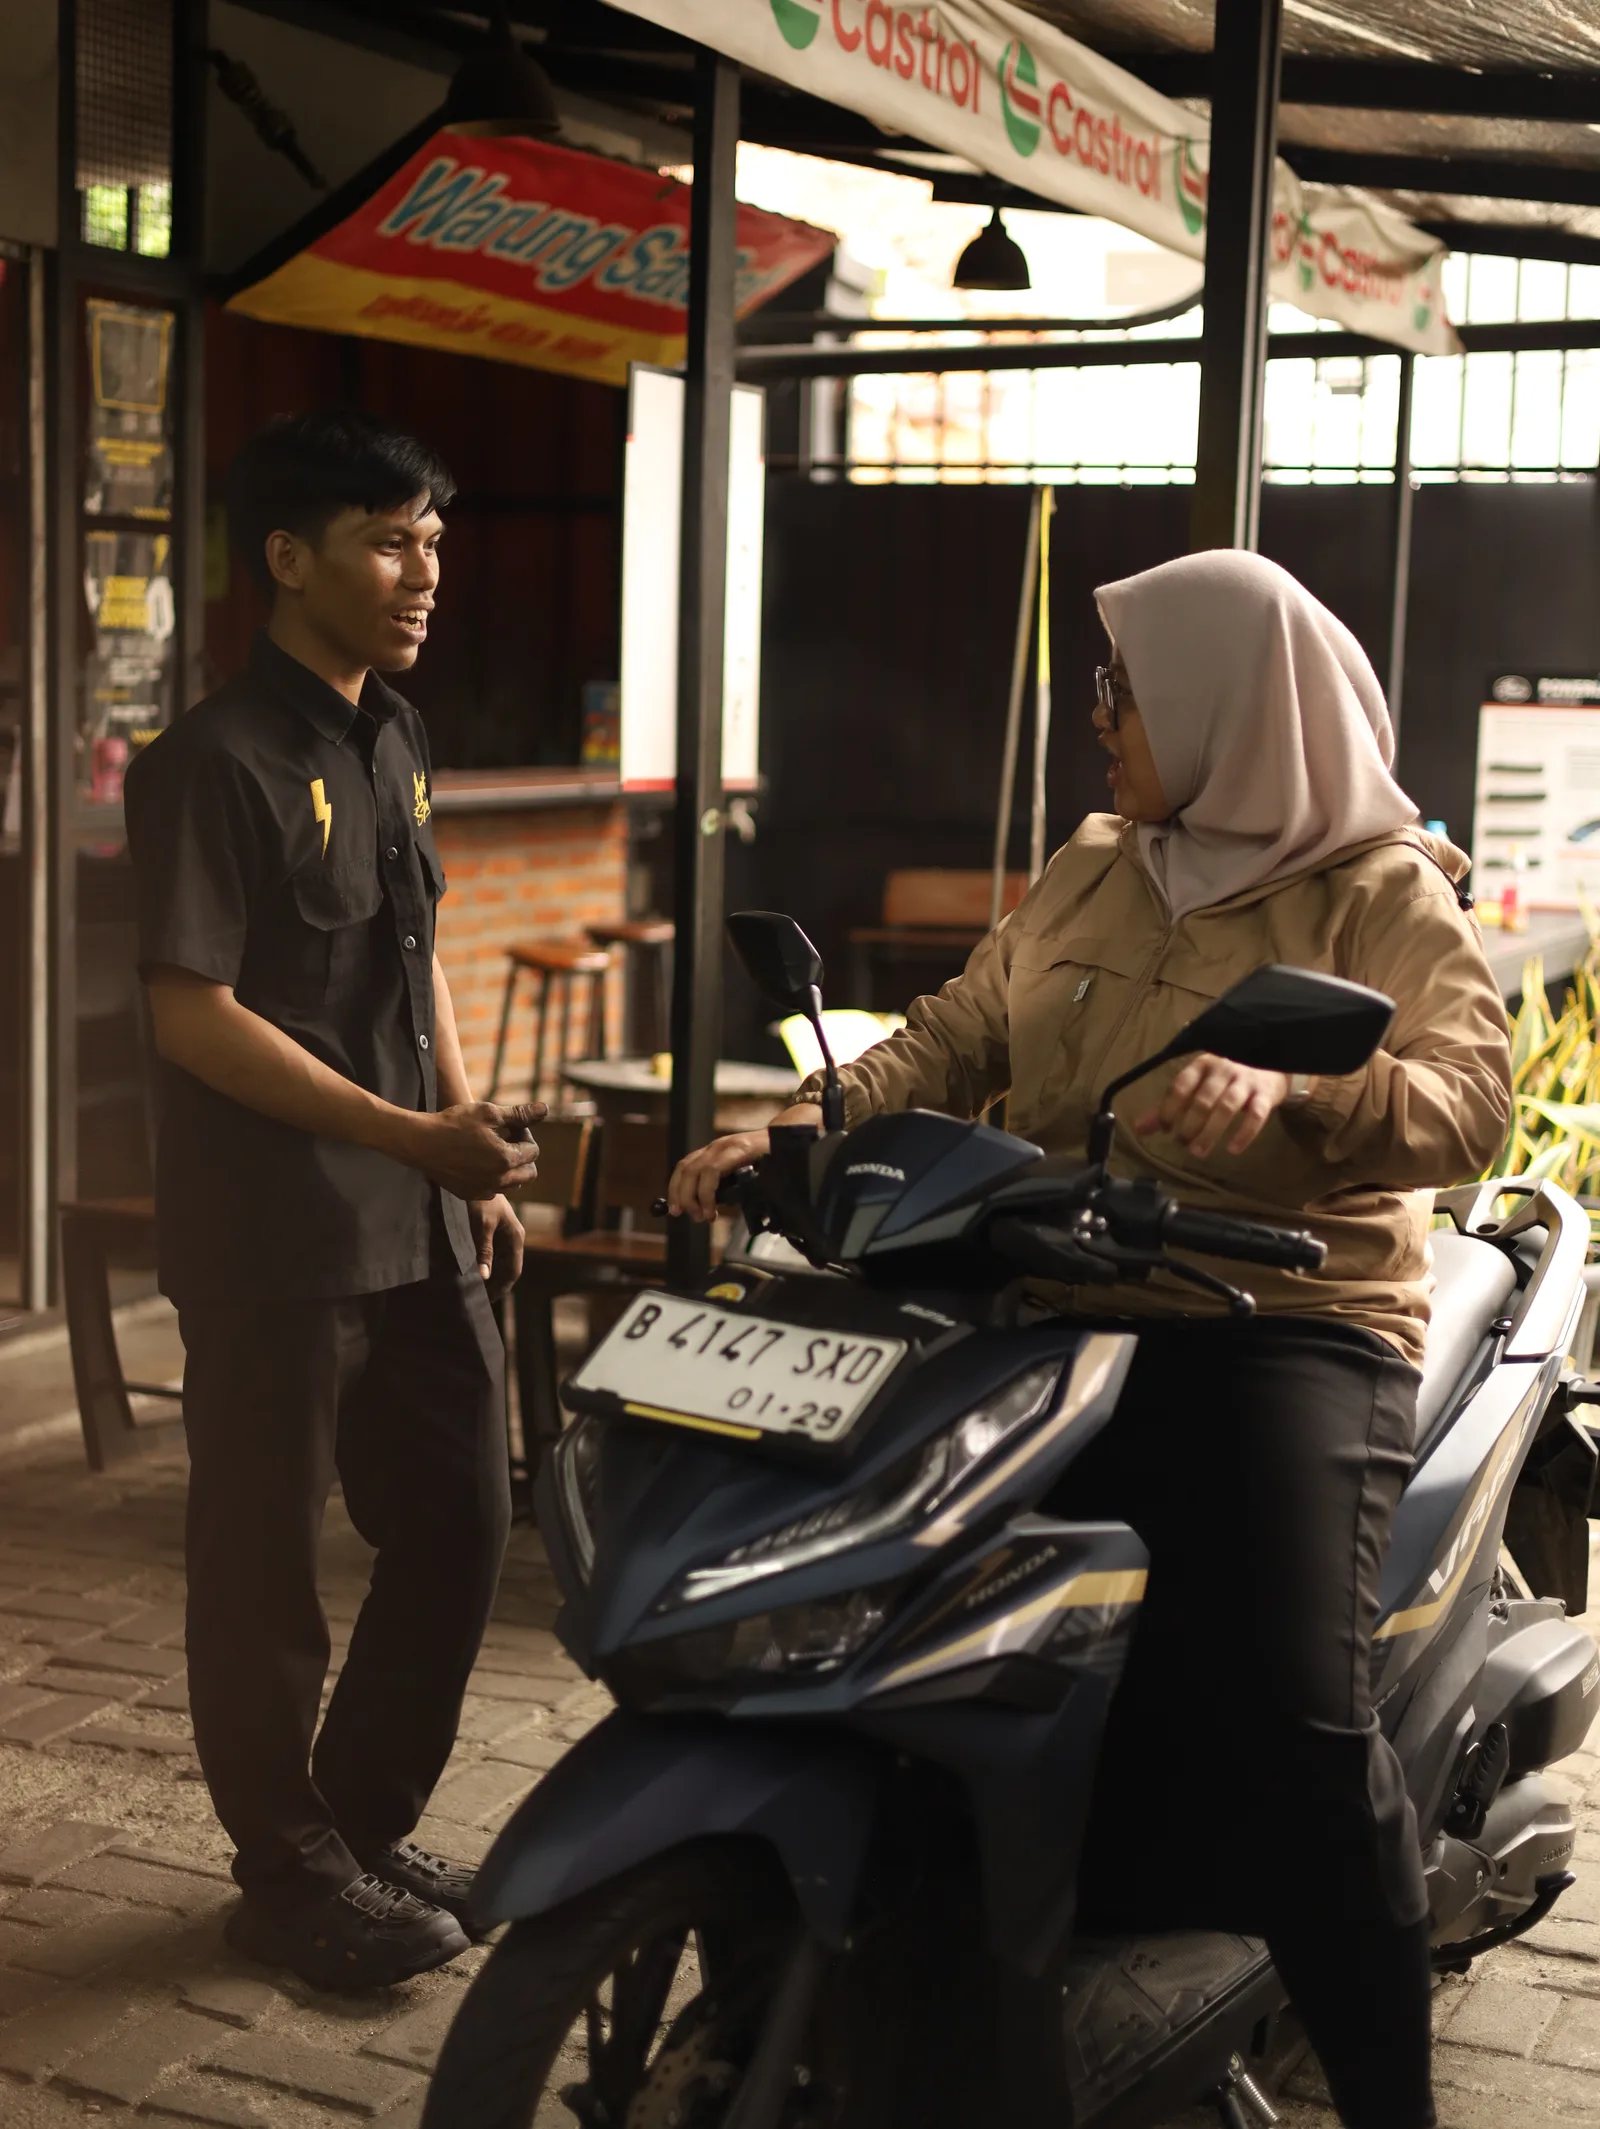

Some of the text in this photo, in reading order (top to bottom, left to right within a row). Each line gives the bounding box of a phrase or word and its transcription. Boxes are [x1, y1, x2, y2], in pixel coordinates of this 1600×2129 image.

[831, 0, 1161, 202] Castrol Castrol
[379, 158, 634, 291] Warung
[846, 1163, 906, 1181] HONDA
[624, 1303, 884, 1385] B 4147 SXD
